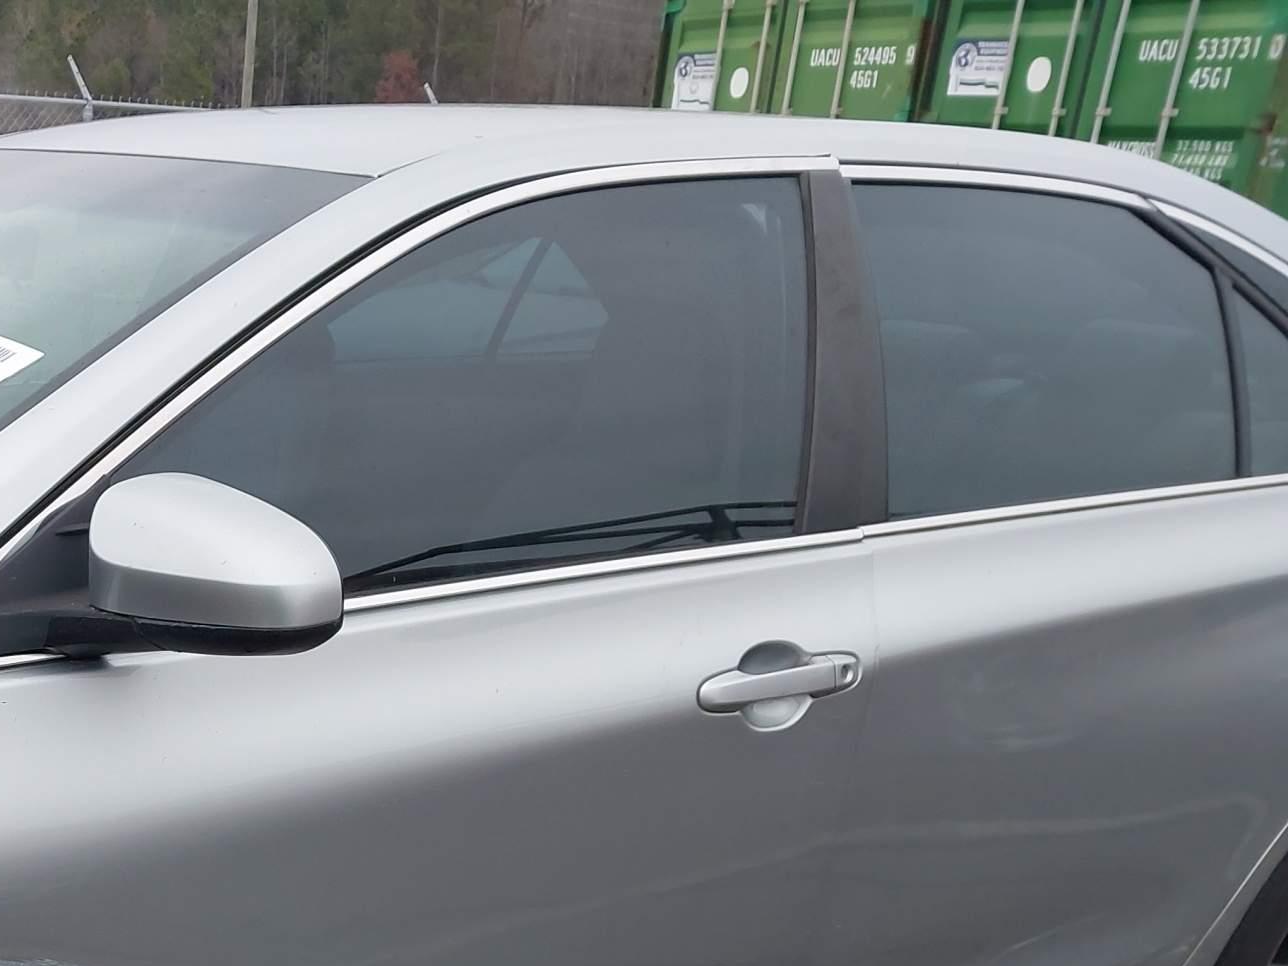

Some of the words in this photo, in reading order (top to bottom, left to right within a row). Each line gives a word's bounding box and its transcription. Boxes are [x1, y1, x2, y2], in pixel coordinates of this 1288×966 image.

[810, 47, 841, 67] UACU
[853, 45, 897, 66] 524495
[905, 43, 917, 65] 9
[1139, 39, 1178, 61] UACU
[1195, 35, 1262, 61] 533731
[849, 69, 879, 89] 45G1
[1189, 67, 1232, 89] 45G1
